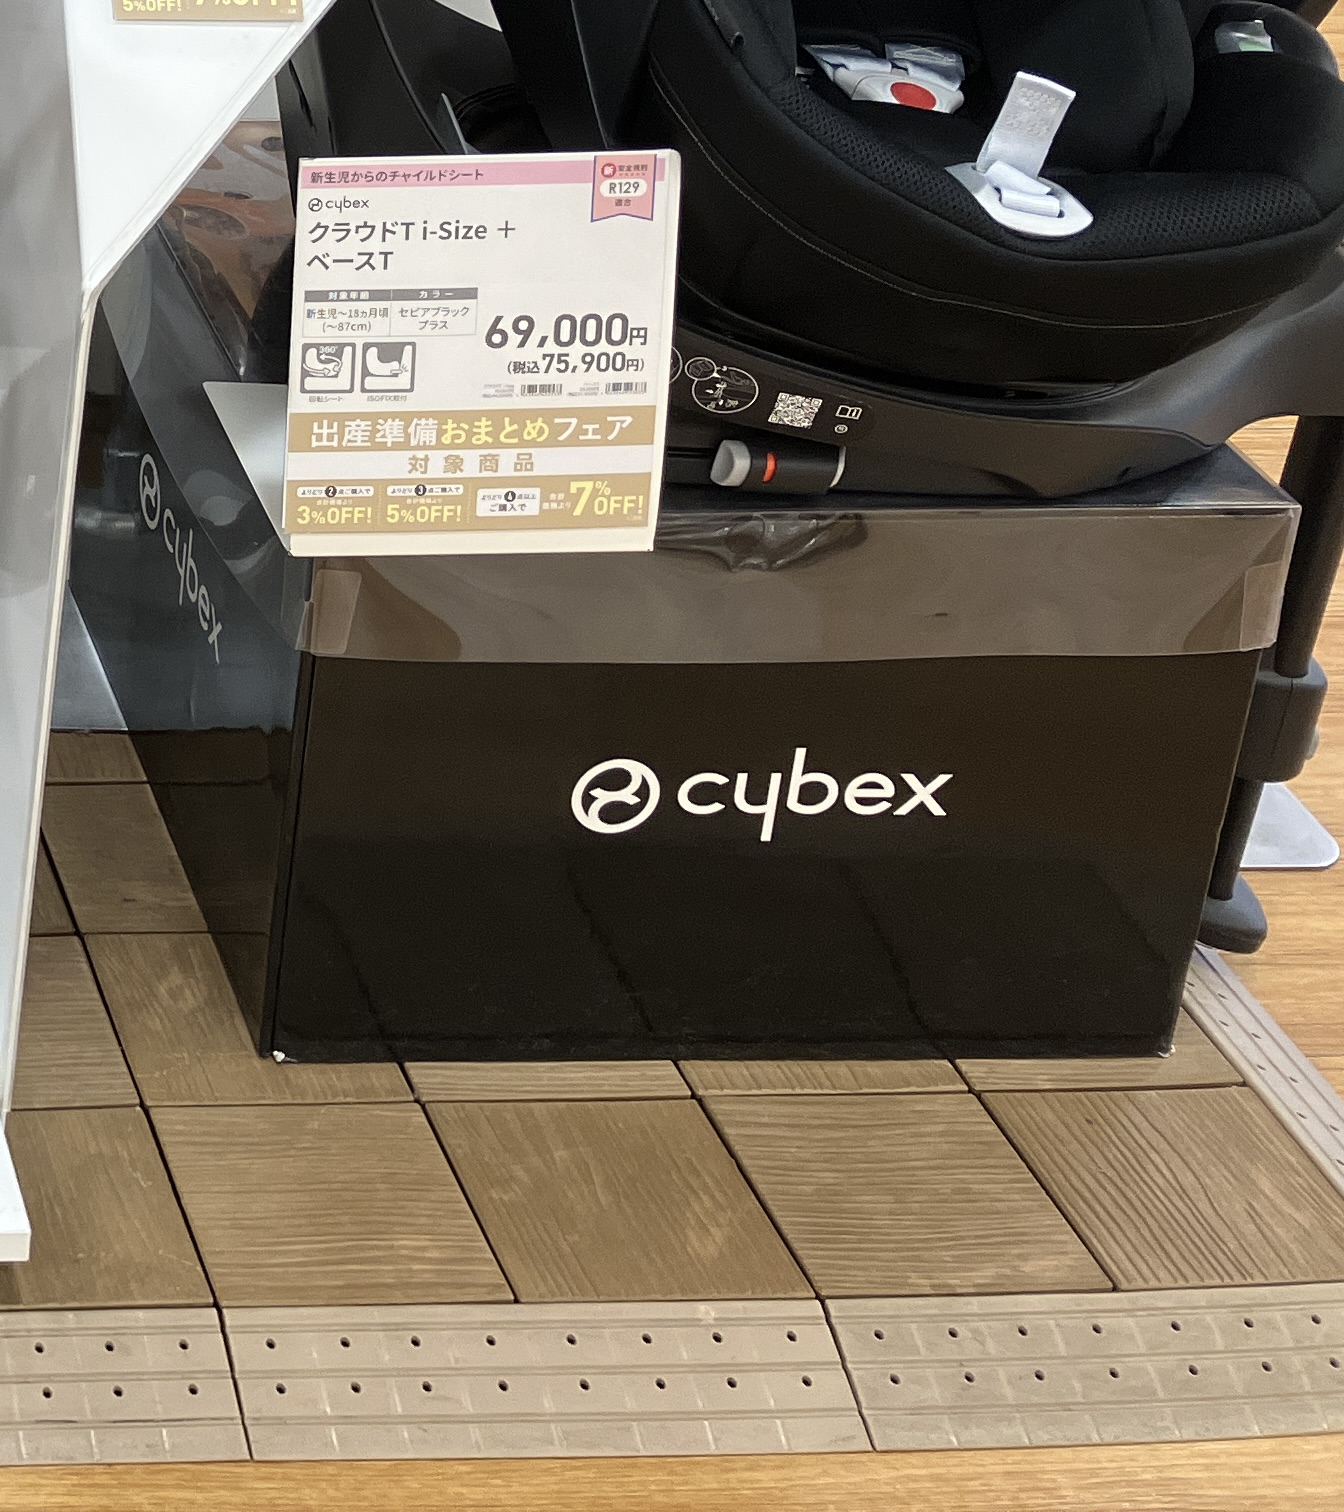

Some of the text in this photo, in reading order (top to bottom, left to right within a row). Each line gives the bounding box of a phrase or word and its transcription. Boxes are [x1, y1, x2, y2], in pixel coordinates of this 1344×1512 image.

[310, 168, 485, 185] 新生児からのチャイルドシート
[608, 181, 641, 195] R129
[325, 196, 371, 213] cybex
[308, 219, 488, 245] クラウドT i-Size
[306, 250, 395, 272] ベースT
[418, 290, 455, 299] カラー
[418, 319, 449, 331] プラス
[484, 312, 648, 350] 69,000円
[507, 351, 646, 376] (税込75,900円)
[310, 414, 634, 449] 出産準備おまとめフェア
[408, 452, 536, 475] 対象商品
[296, 504, 373, 526] 3%OFF!
[386, 503, 464, 525] 5%OFF!
[489, 502, 528, 513] ご購入で
[593, 494, 645, 517] OFF!
[163, 507, 223, 666] cybex
[677, 747, 955, 843] cybex
